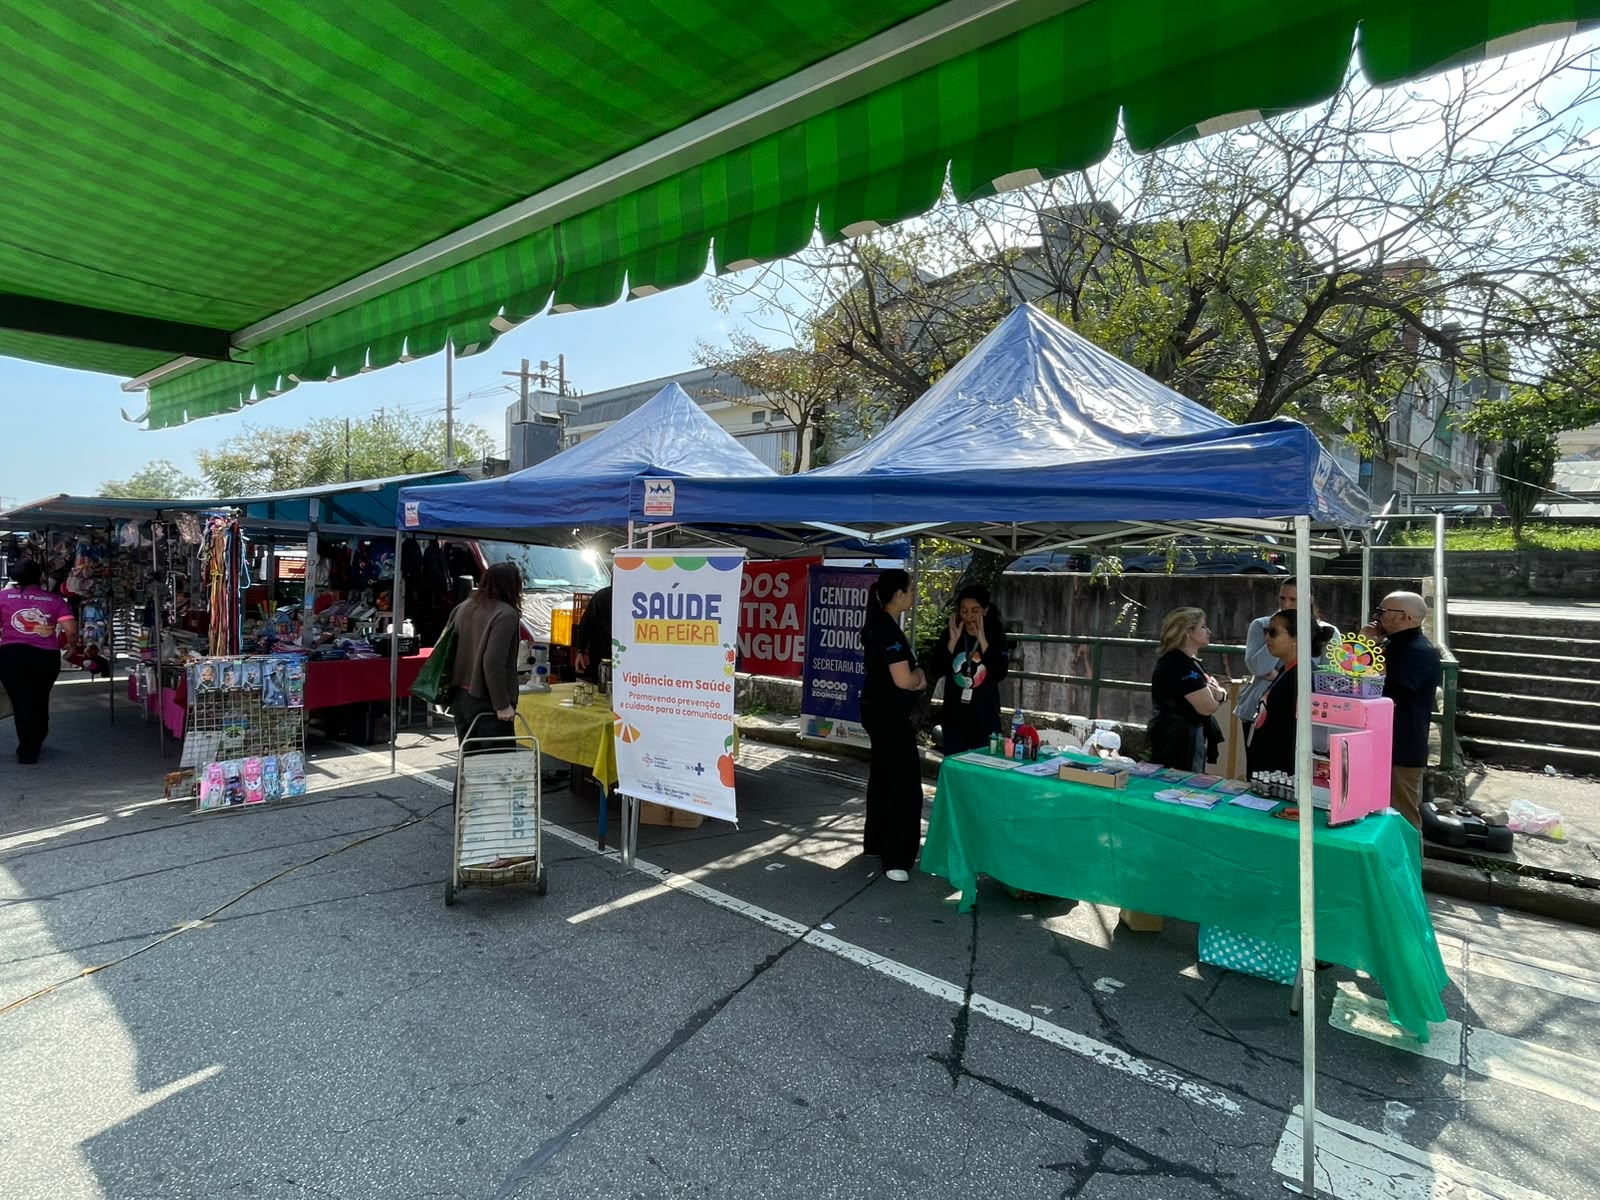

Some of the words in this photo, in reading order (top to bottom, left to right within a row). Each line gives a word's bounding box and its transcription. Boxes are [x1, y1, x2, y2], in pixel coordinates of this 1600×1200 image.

[631, 582, 722, 624] SAÚDE
[820, 586, 869, 607] CENTRO
[637, 623, 660, 641] NA
[820, 629, 865, 650] ZOONO
[812, 657, 854, 673] SECRETARIA
[855, 662, 865, 674] DE
[622, 672, 674, 687] Vigilância
[675, 679, 693, 689] em
[695, 679, 732, 693] Saúde
[629, 691, 677, 704] Promovendo
[677, 697, 721, 710] prevenção
[625, 701, 655, 712] cuidado
[655, 706, 674, 714] para
[681, 709, 732, 722] comunidade
